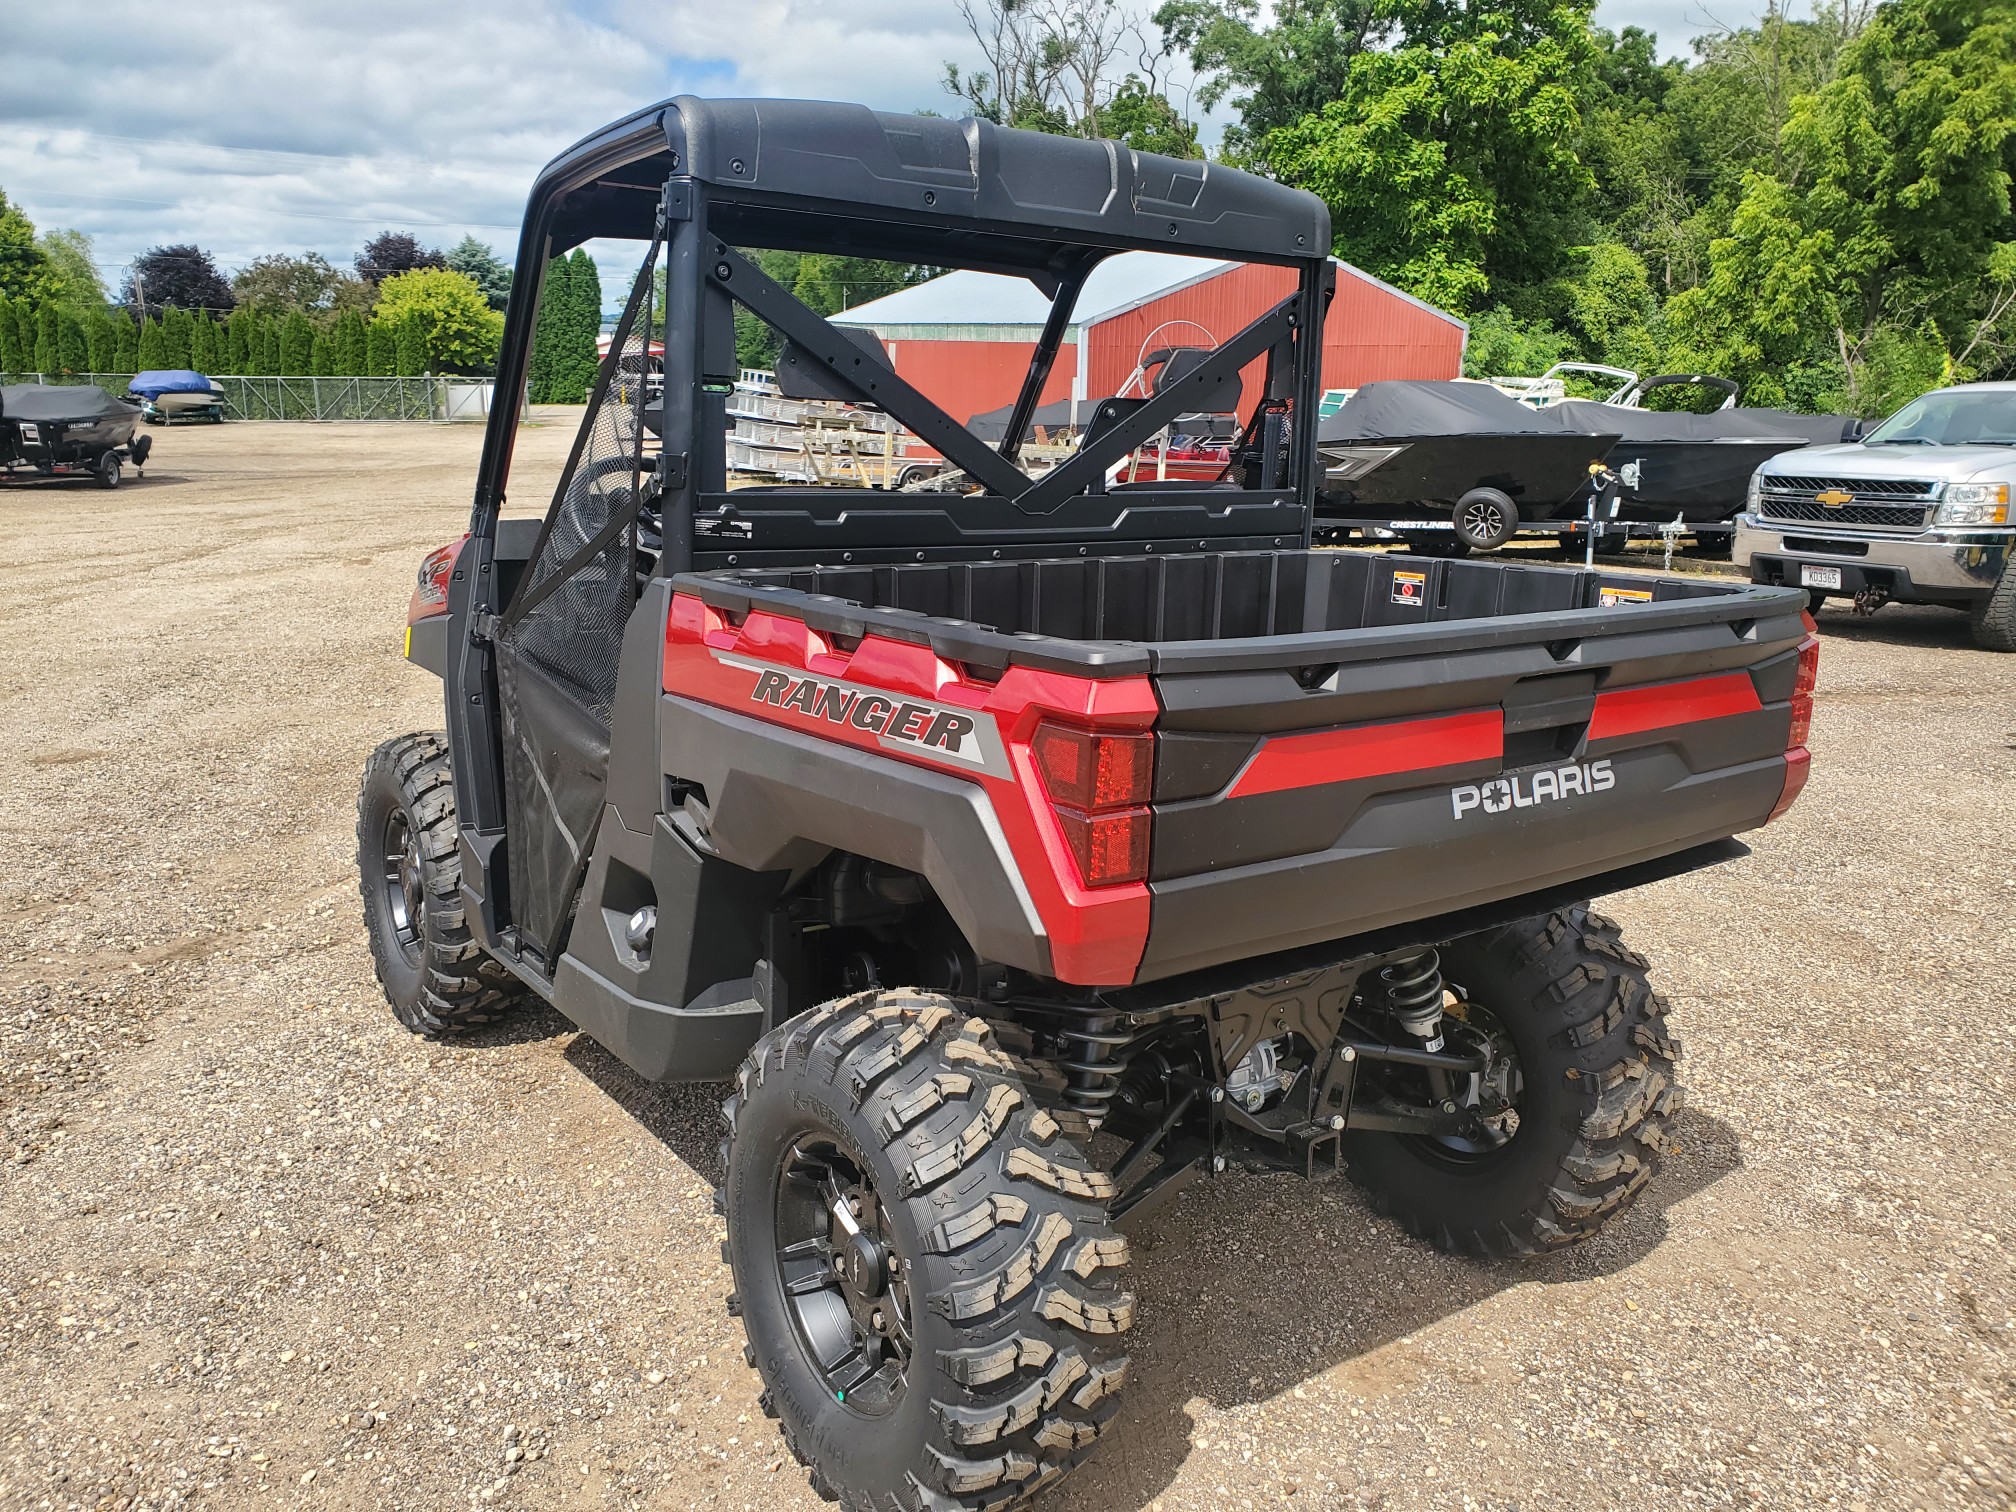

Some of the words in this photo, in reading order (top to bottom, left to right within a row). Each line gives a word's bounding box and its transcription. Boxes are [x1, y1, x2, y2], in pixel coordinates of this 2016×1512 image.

[419, 560, 451, 585] XP
[1808, 570, 1837, 584] KD3365
[751, 668, 975, 753] RANGER
[1451, 759, 1616, 820] POLARIS
